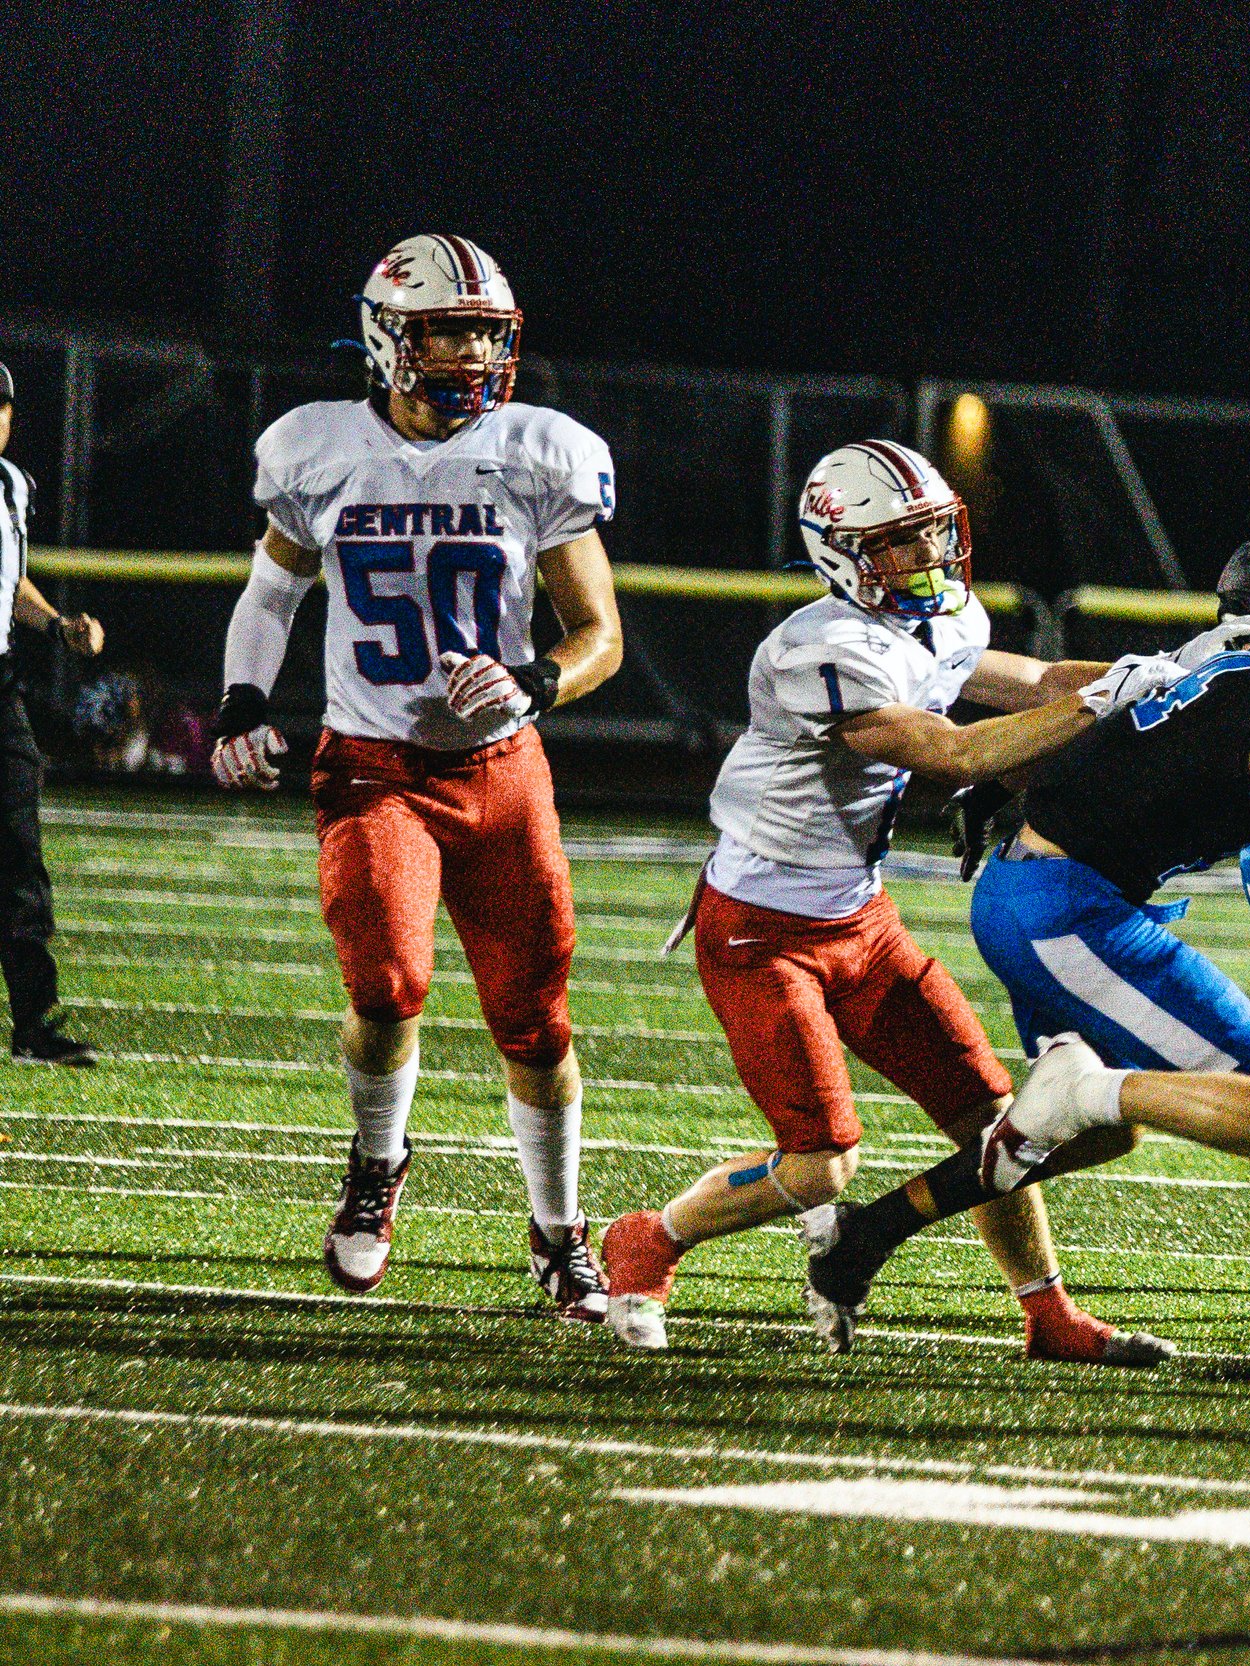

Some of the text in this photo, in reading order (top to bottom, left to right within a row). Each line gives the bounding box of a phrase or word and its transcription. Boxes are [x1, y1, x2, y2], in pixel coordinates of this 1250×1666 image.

[335, 503, 504, 536] CENTRAL
[335, 541, 508, 686] 50
[819, 663, 844, 715] 1
